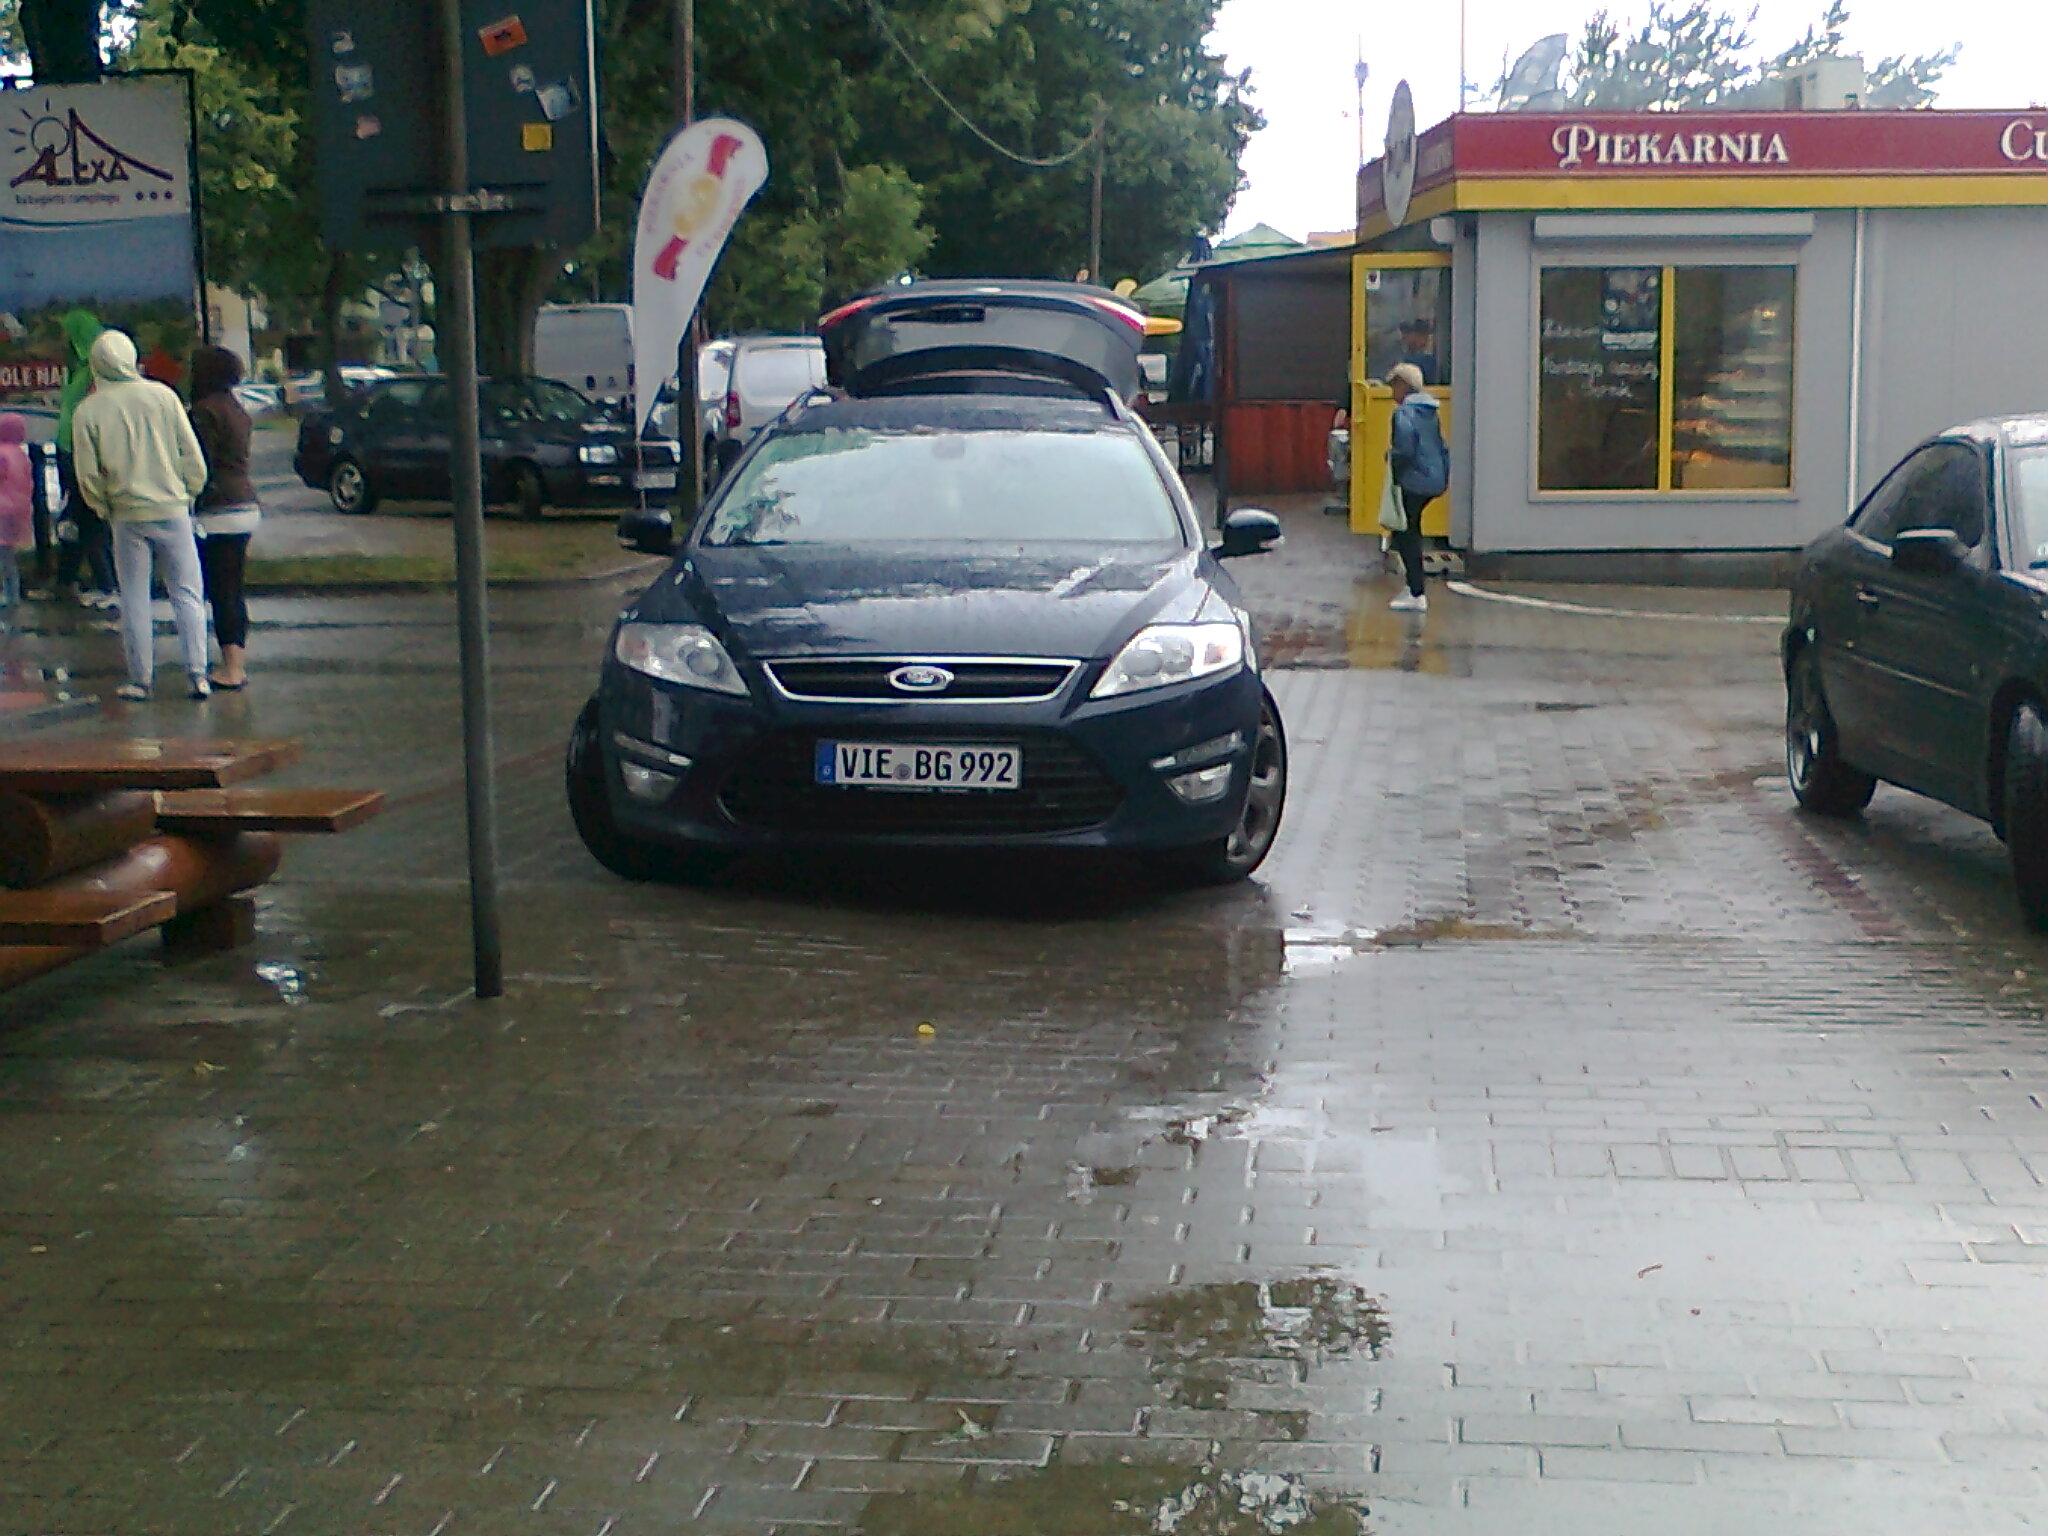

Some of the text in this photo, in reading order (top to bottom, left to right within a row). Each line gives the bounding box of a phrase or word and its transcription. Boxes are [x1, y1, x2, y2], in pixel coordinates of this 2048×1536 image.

[1552, 124, 1790, 169] PIEKARNIA
[841, 747, 1013, 783] VIE BG 992
